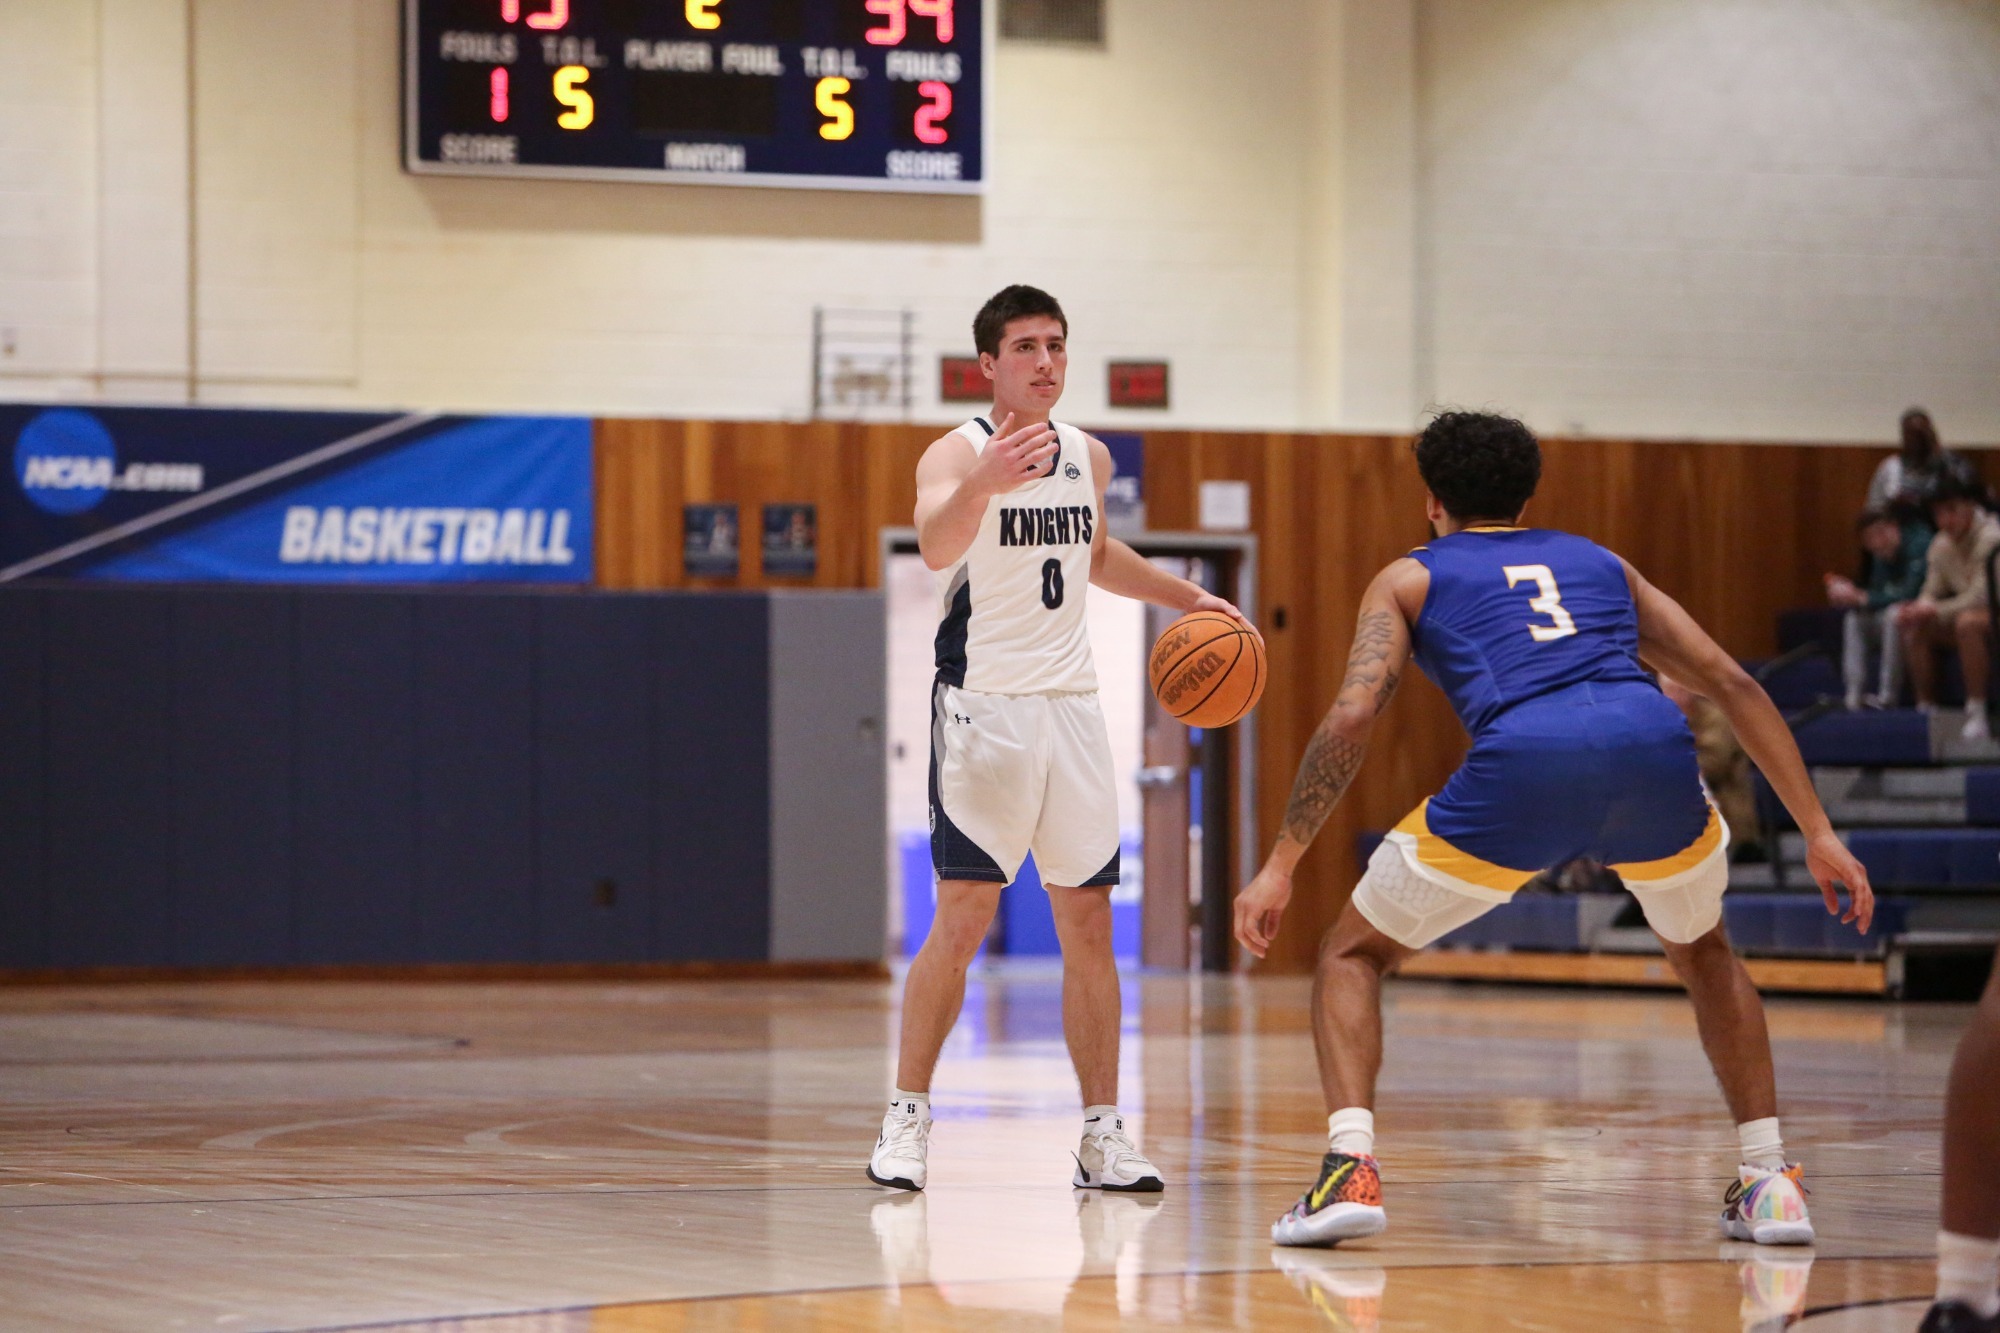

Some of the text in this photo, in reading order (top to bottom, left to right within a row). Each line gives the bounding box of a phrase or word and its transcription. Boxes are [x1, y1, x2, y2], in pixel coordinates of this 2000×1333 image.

[440, 31, 517, 64] FOULS
[624, 39, 713, 72] PLAYER
[886, 51, 962, 84] FOULS
[491, 67, 508, 122] 1
[553, 65, 594, 129] 5
[815, 76, 854, 140] 5
[914, 80, 952, 144] 2
[440, 133, 517, 163] SCORE
[886, 151, 962, 180] SCORE
[279, 506, 573, 564] BASKETBALL
[1000, 505, 1093, 546] KNIGHTS
[1041, 558, 1064, 610] 0
[1502, 564, 1578, 641] 3
